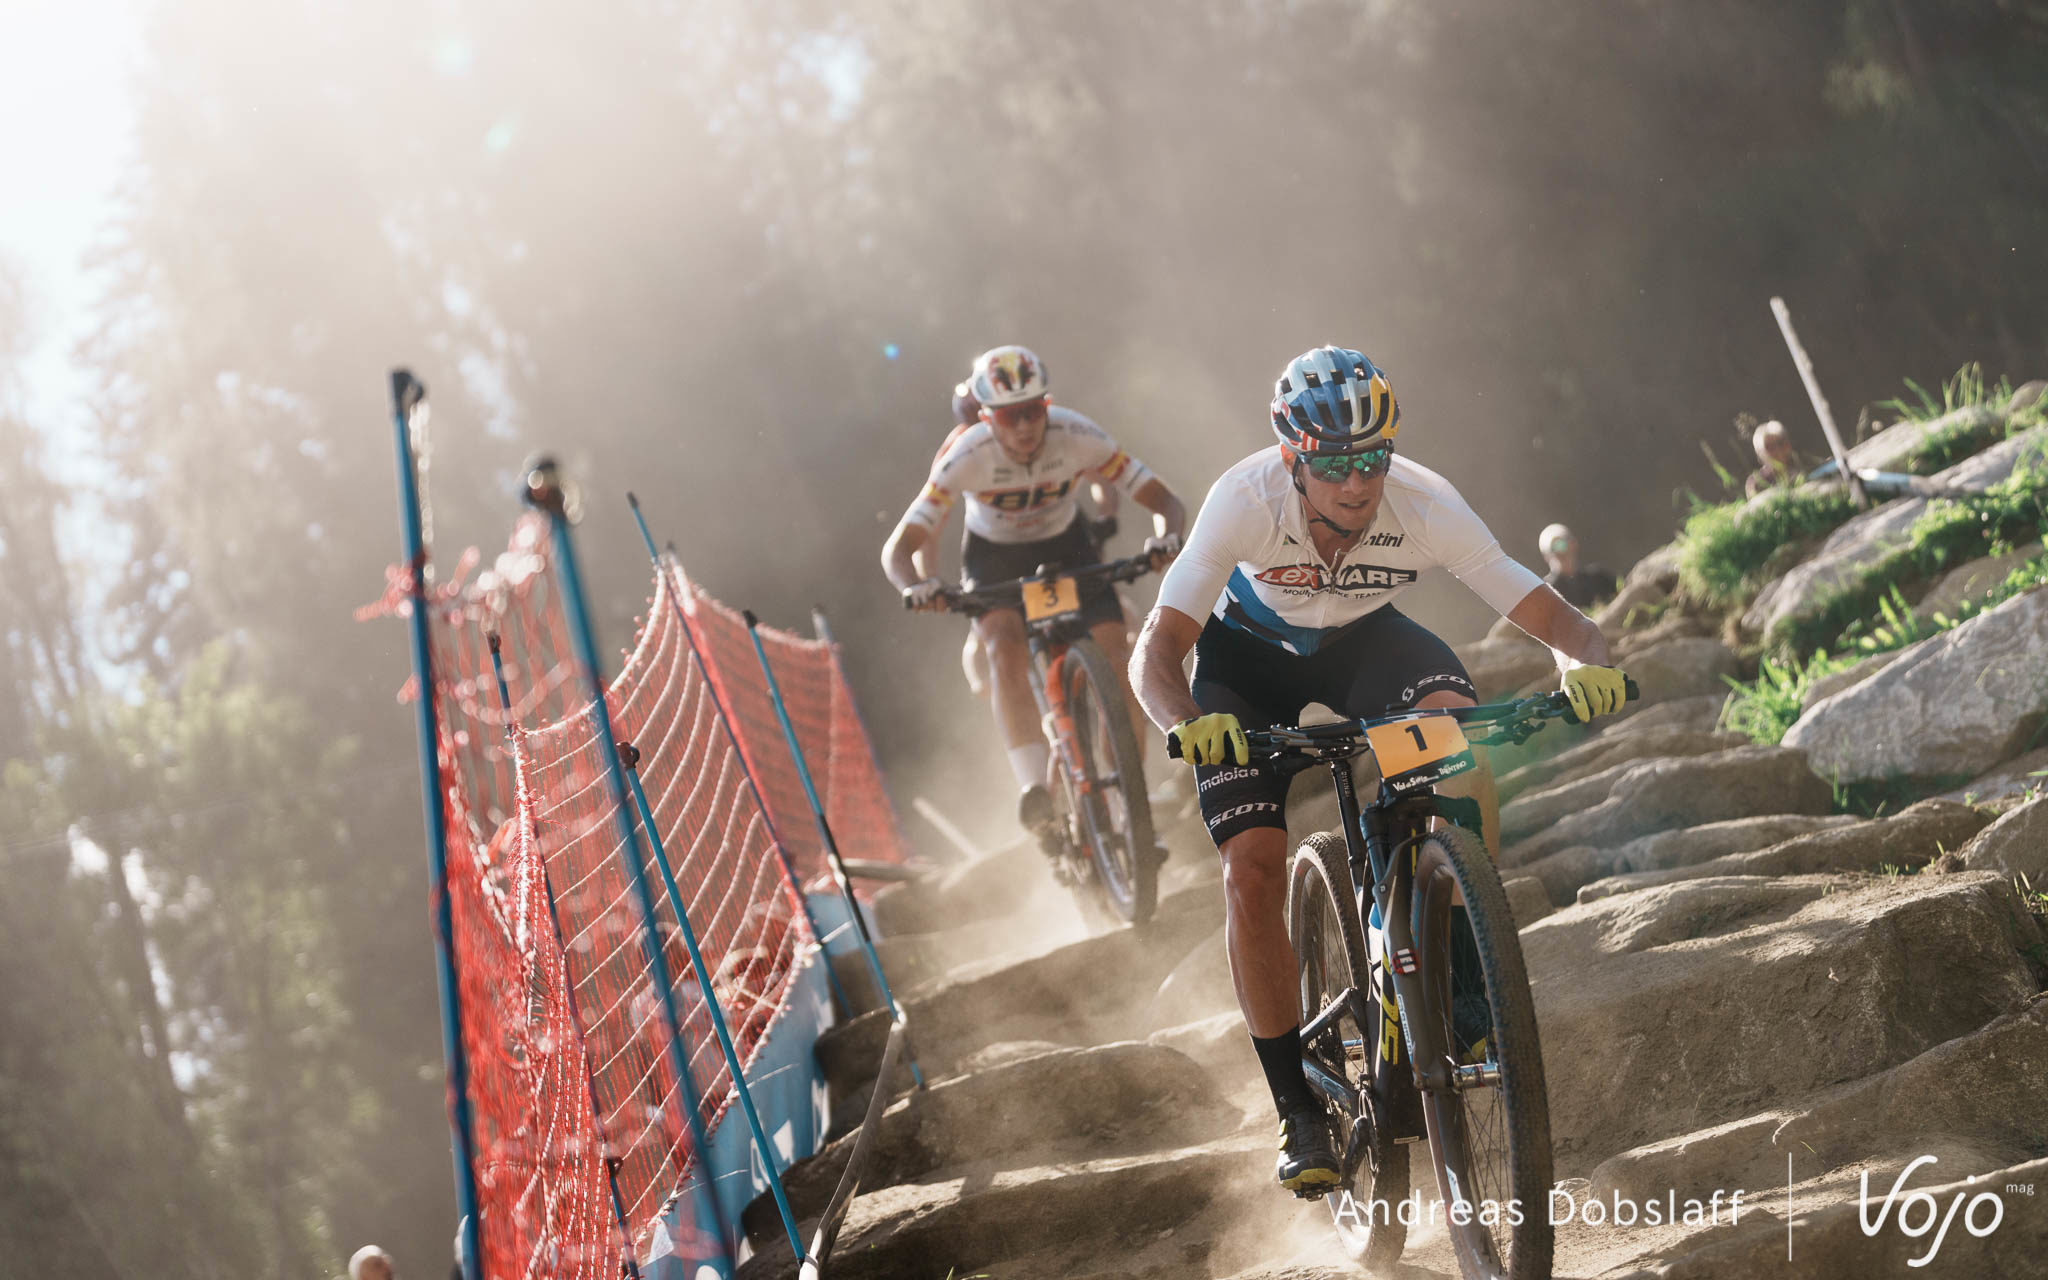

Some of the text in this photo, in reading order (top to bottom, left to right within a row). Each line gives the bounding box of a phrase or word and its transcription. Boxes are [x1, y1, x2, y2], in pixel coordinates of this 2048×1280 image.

[1364, 533, 1405, 547] ntini
[1043, 582, 1058, 608] 3
[1417, 674, 1475, 690] SCOT
[1405, 724, 1427, 752] 1
[1200, 767, 1249, 792] maloja
[1209, 802, 1280, 830] SCOTT
